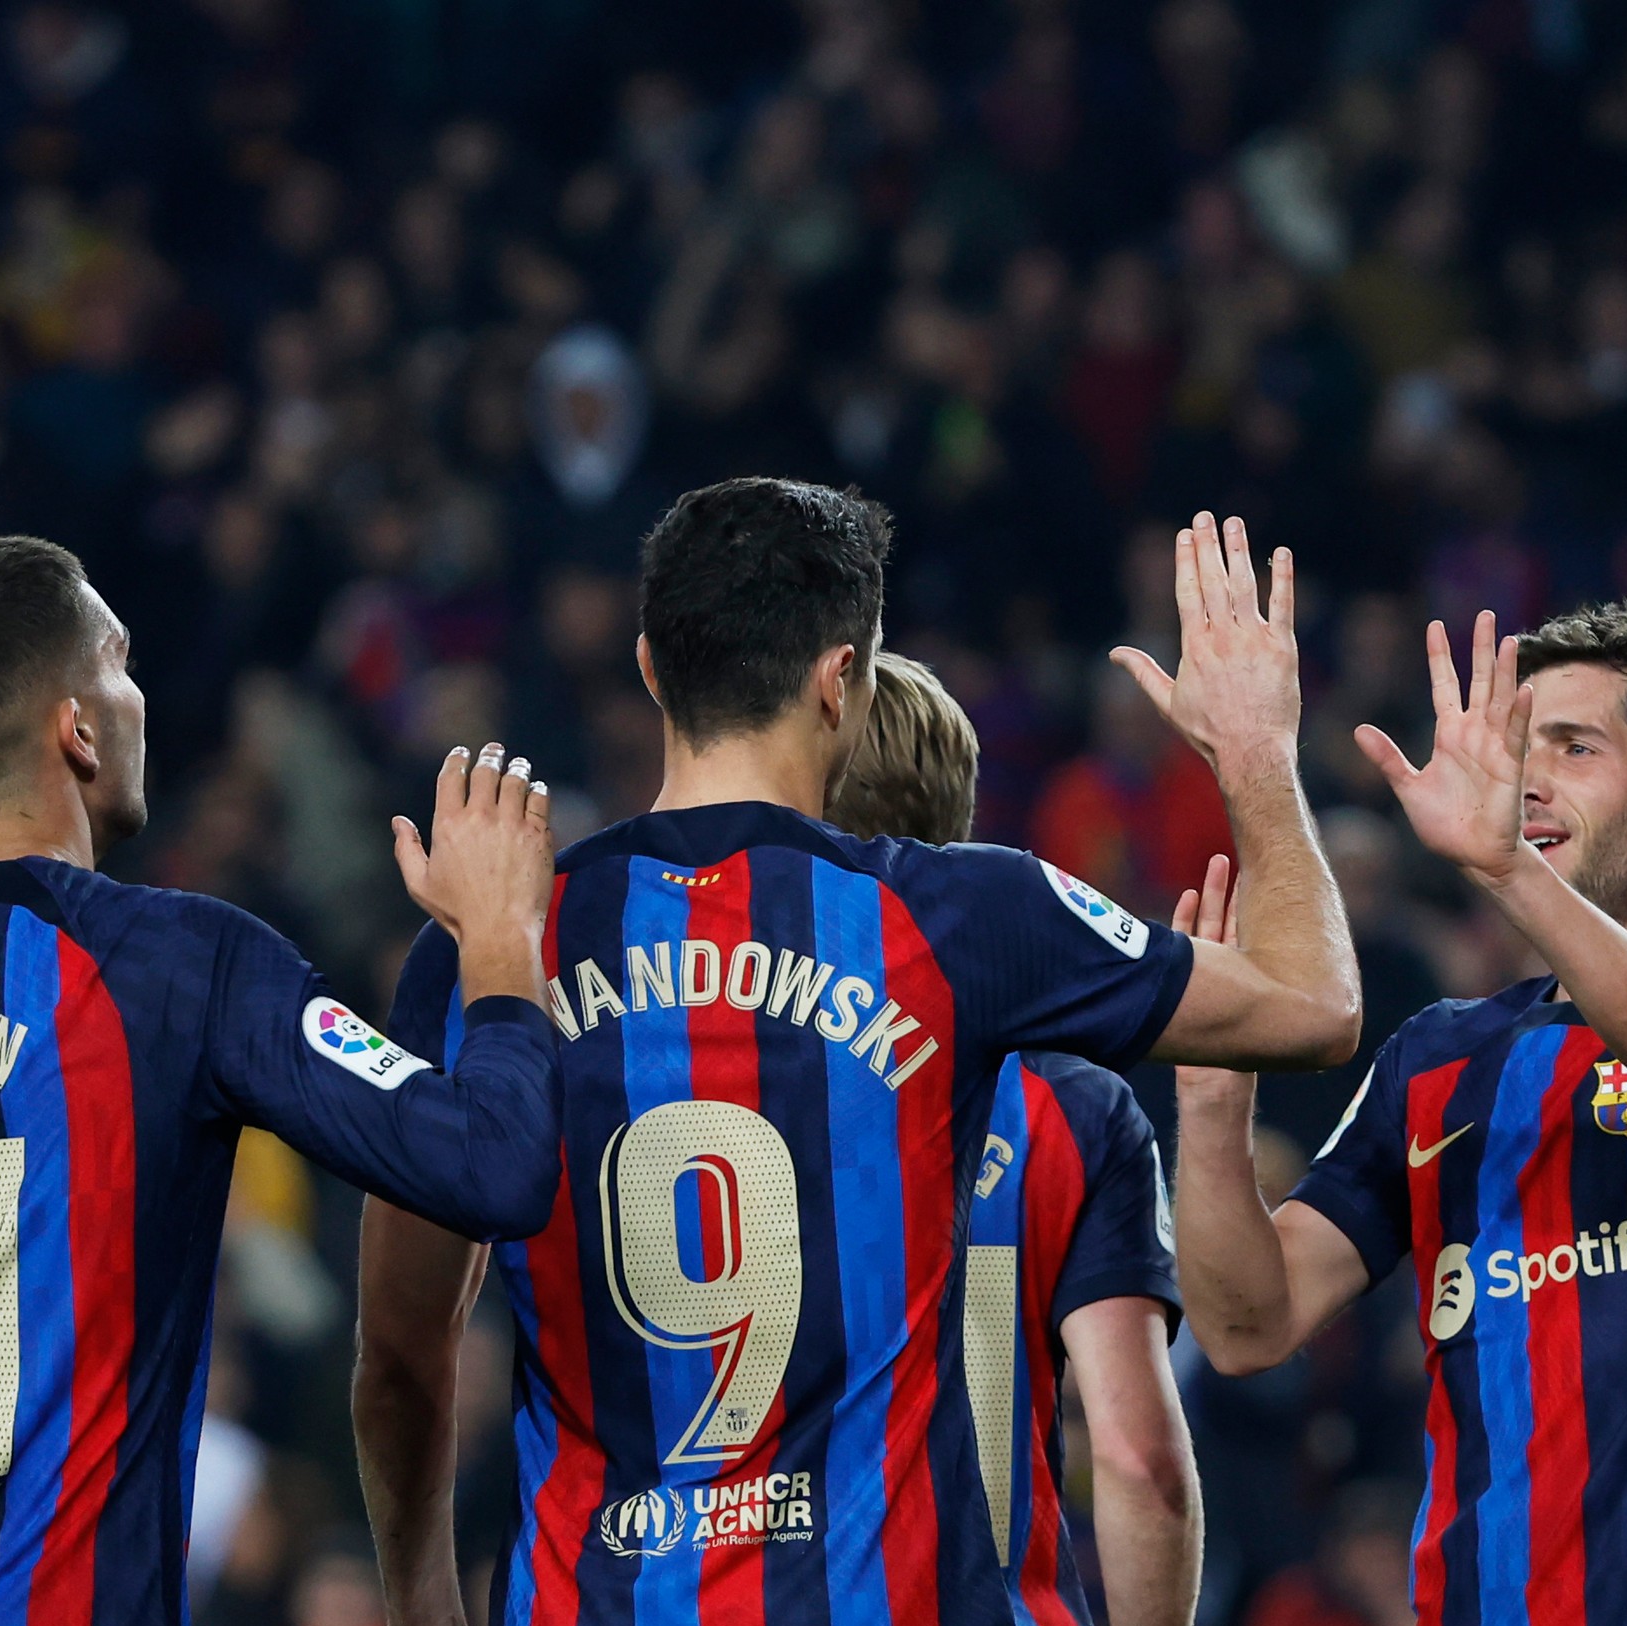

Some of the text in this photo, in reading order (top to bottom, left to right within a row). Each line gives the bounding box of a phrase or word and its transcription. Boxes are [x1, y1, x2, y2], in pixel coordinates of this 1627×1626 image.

[598, 1100, 803, 1466] 9
[693, 1471, 812, 1515] UNHCR
[691, 1499, 814, 1543] ACNUR
[692, 1542, 711, 1552] The
[711, 1536, 728, 1549] UN
[771, 1531, 814, 1544] Agency
